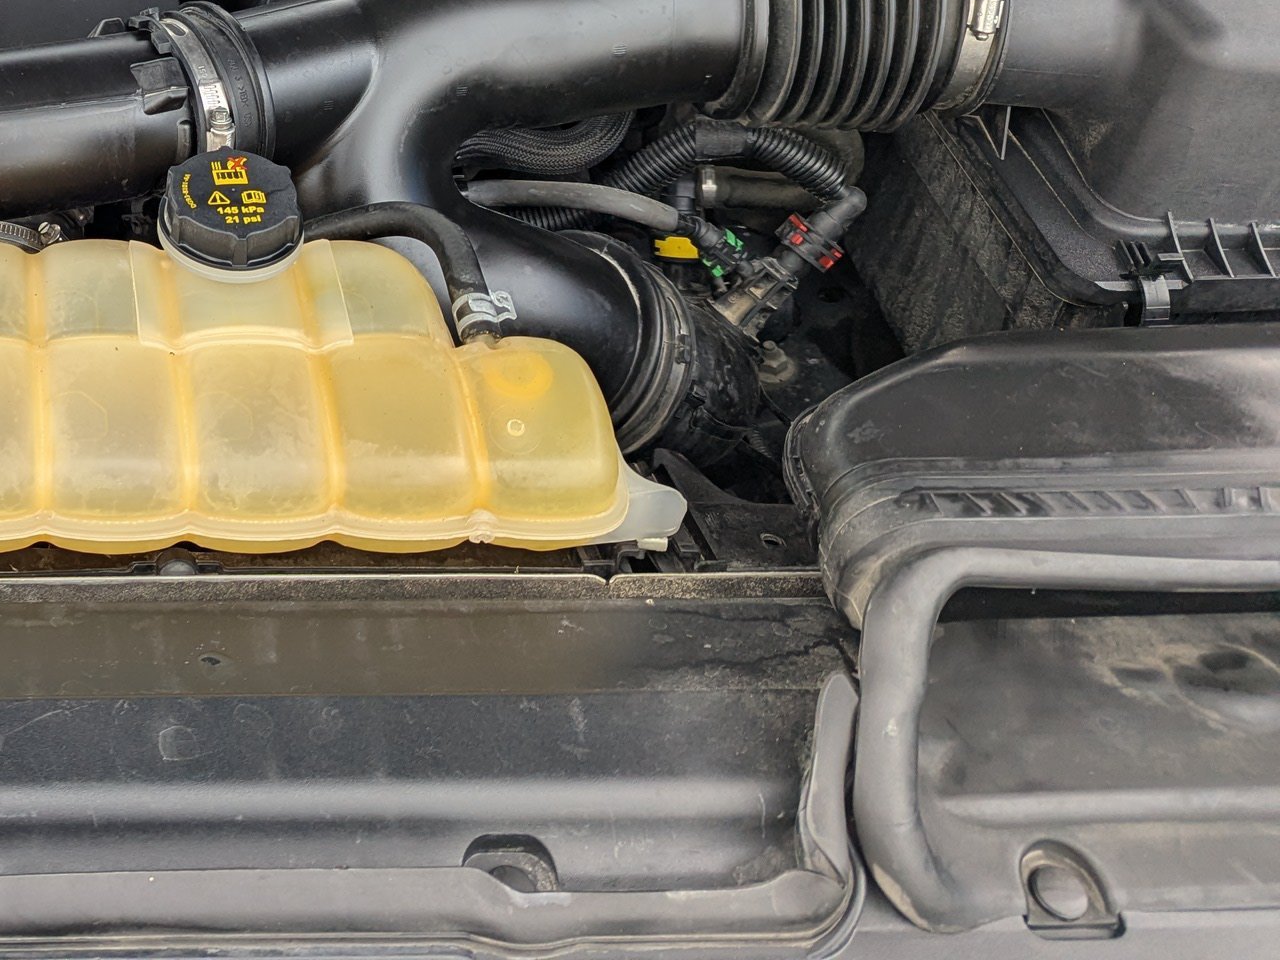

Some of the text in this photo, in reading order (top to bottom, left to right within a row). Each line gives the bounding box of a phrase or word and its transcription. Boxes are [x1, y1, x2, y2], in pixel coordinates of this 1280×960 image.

[216, 206, 264, 214] 145 kPa
[225, 215, 261, 224] 21 psi
